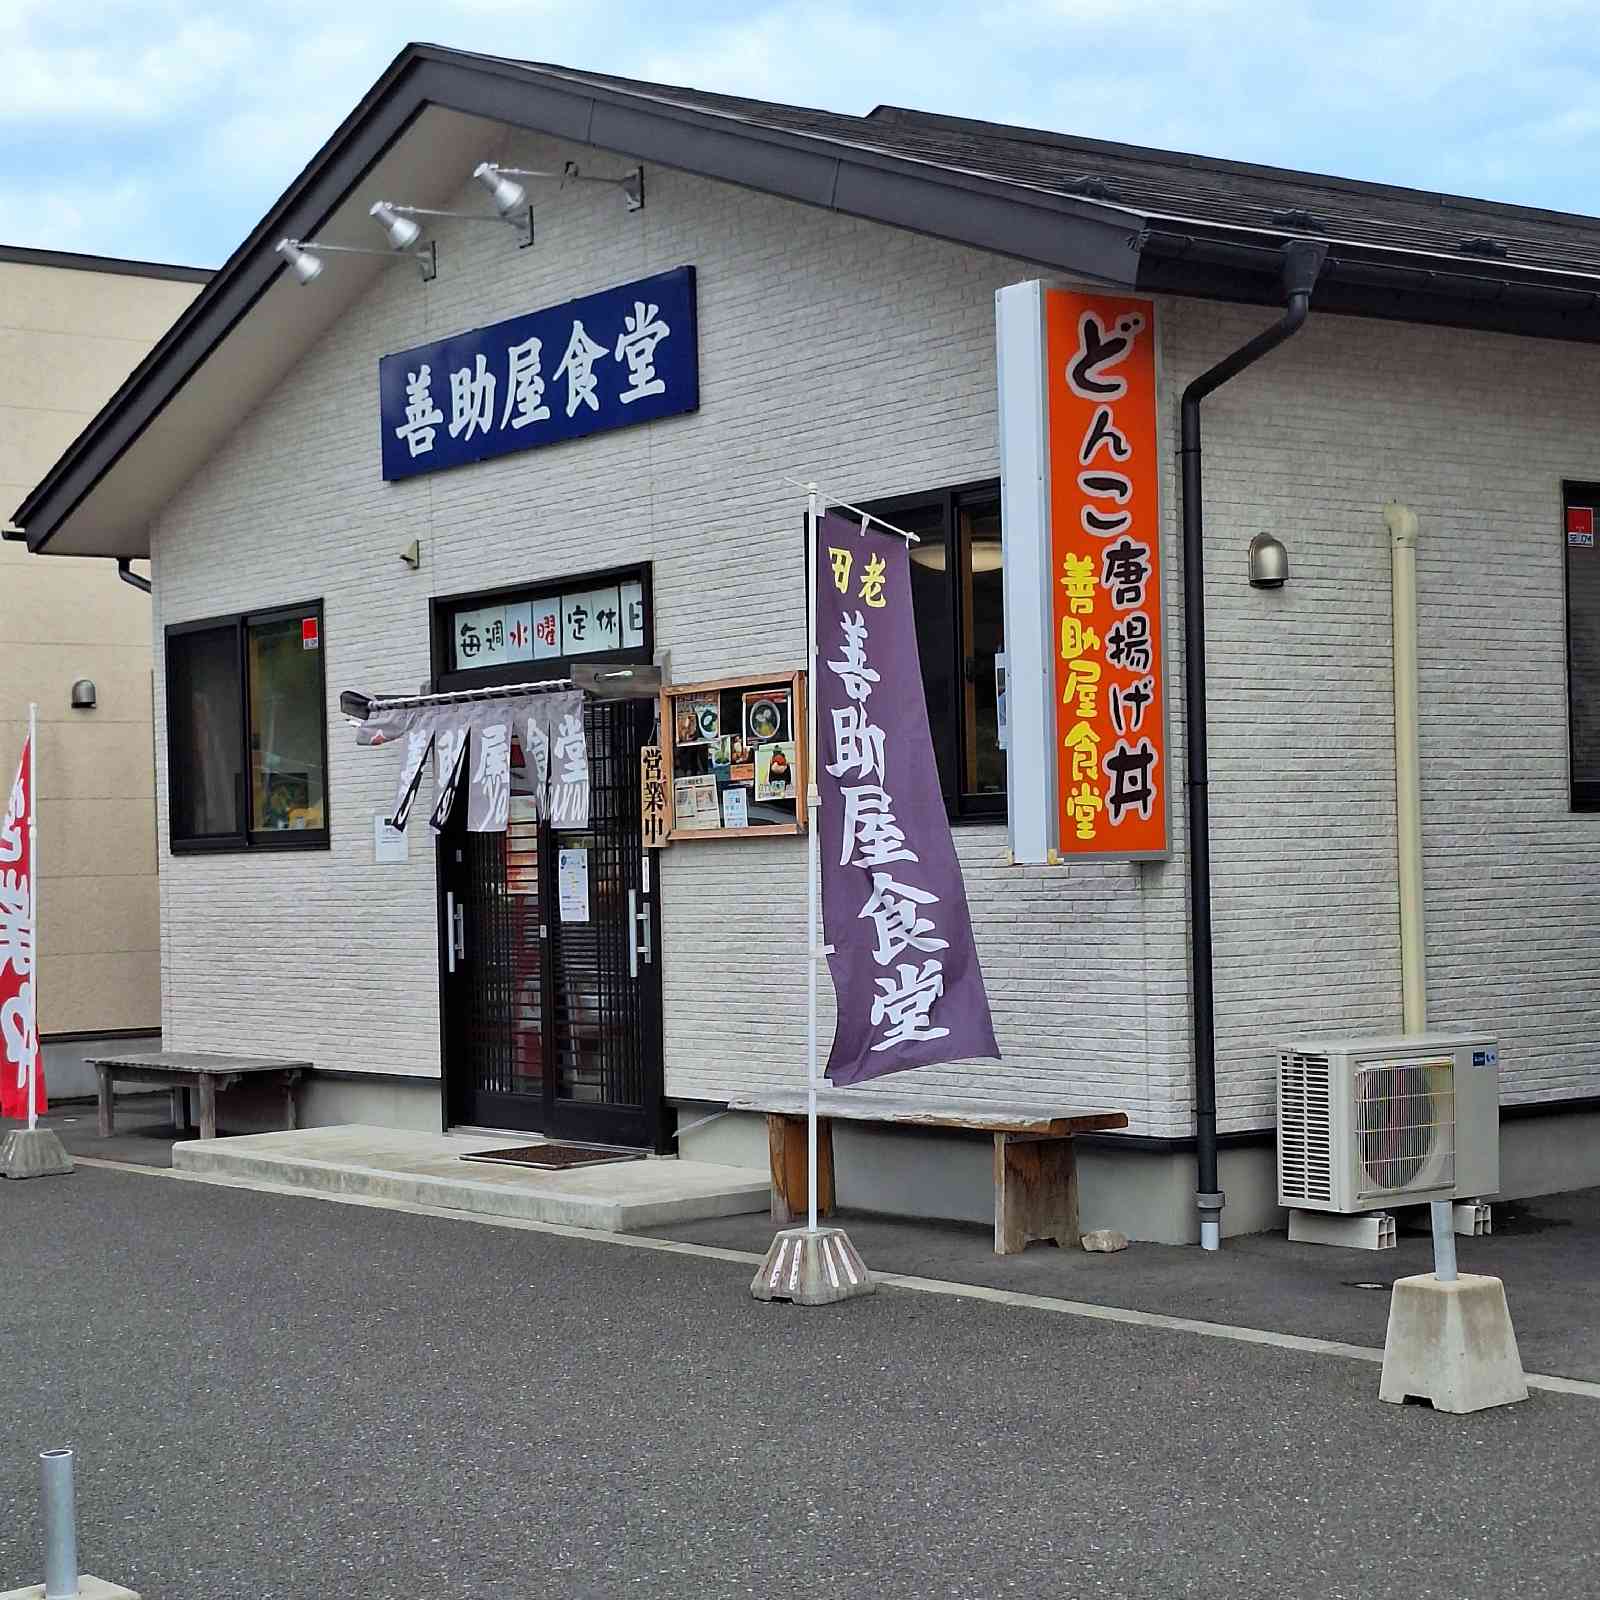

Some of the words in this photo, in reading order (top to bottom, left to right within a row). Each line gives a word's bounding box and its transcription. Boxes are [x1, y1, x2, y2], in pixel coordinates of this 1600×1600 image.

[395, 300, 671, 458] 善助屋食堂
[1060, 552, 1103, 840] 善助屋食堂
[1068, 313, 1157, 824] どんこ唐揚げ丼
[826, 609, 950, 1052] 善助屋食堂
